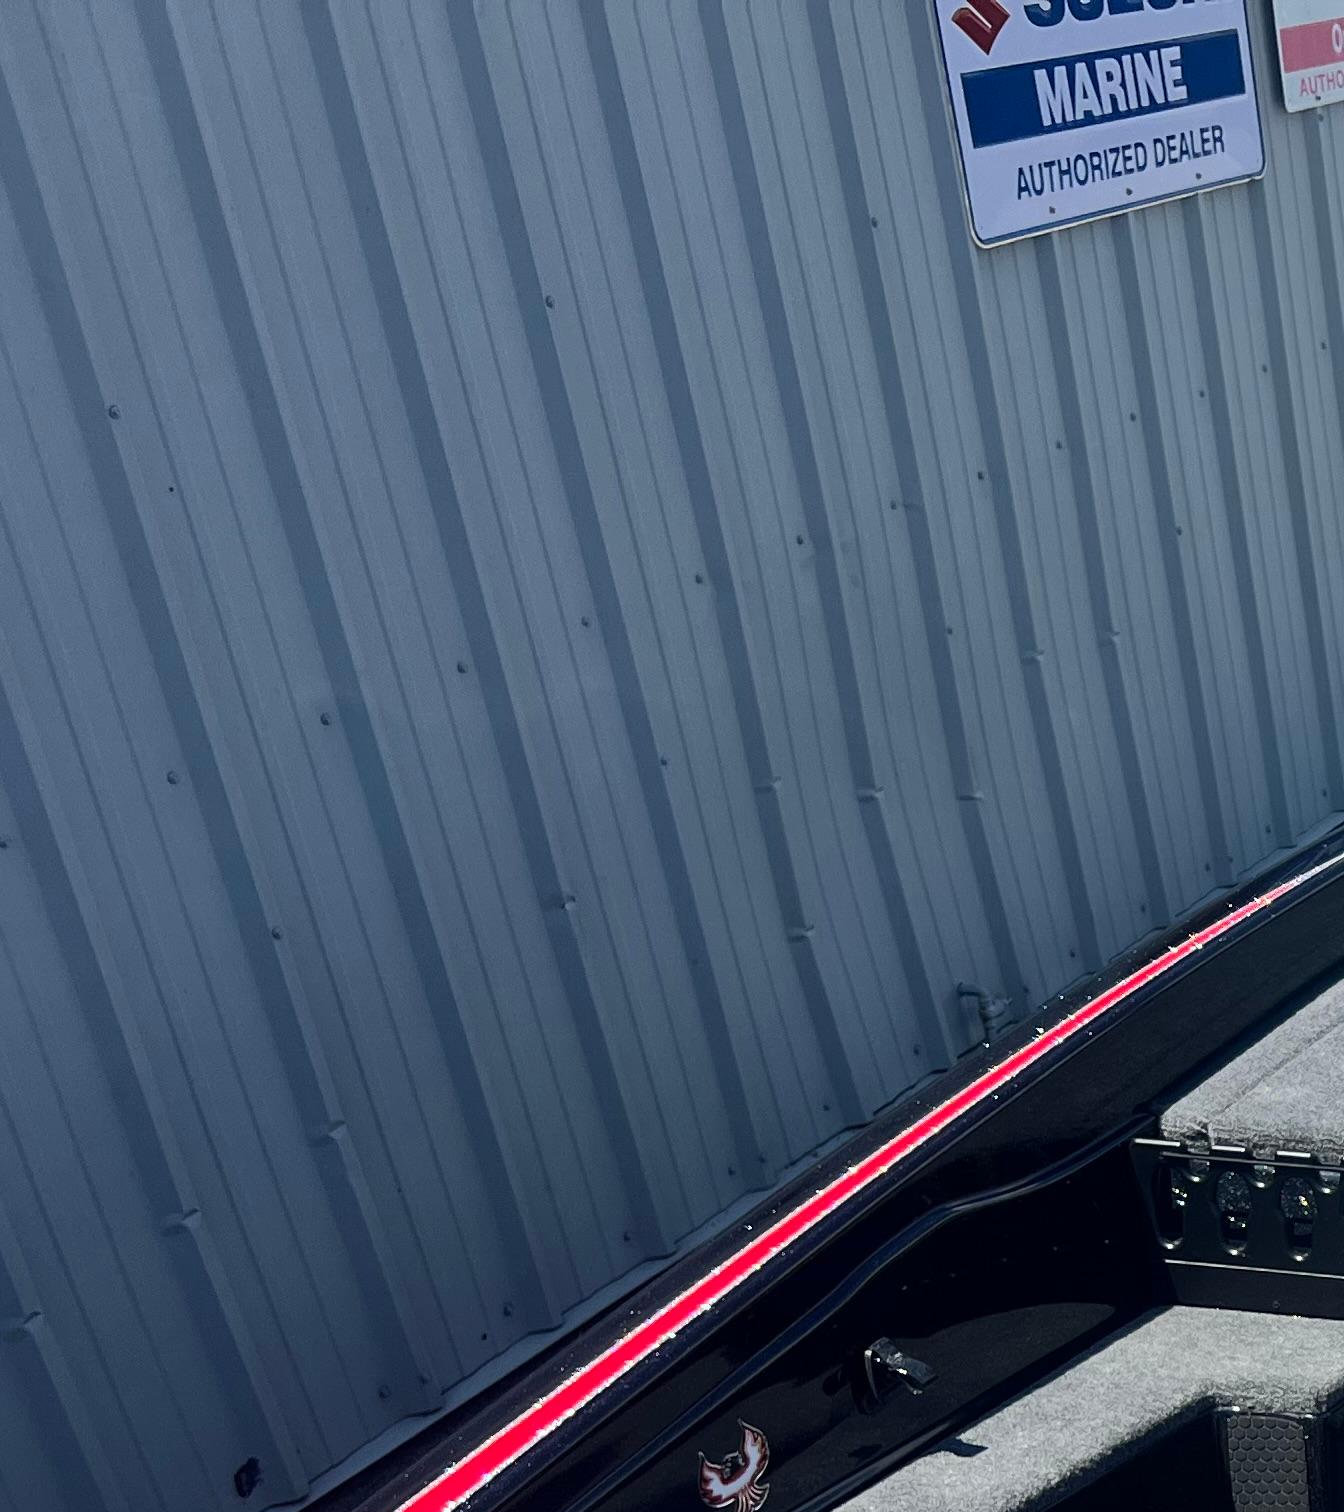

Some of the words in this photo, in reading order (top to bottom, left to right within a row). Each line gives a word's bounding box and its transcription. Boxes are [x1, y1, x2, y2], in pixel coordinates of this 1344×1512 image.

[1034, 45, 1188, 127] MARINE
[1016, 142, 1148, 200] AUTHORIZED
[1153, 125, 1225, 169] DEALER
